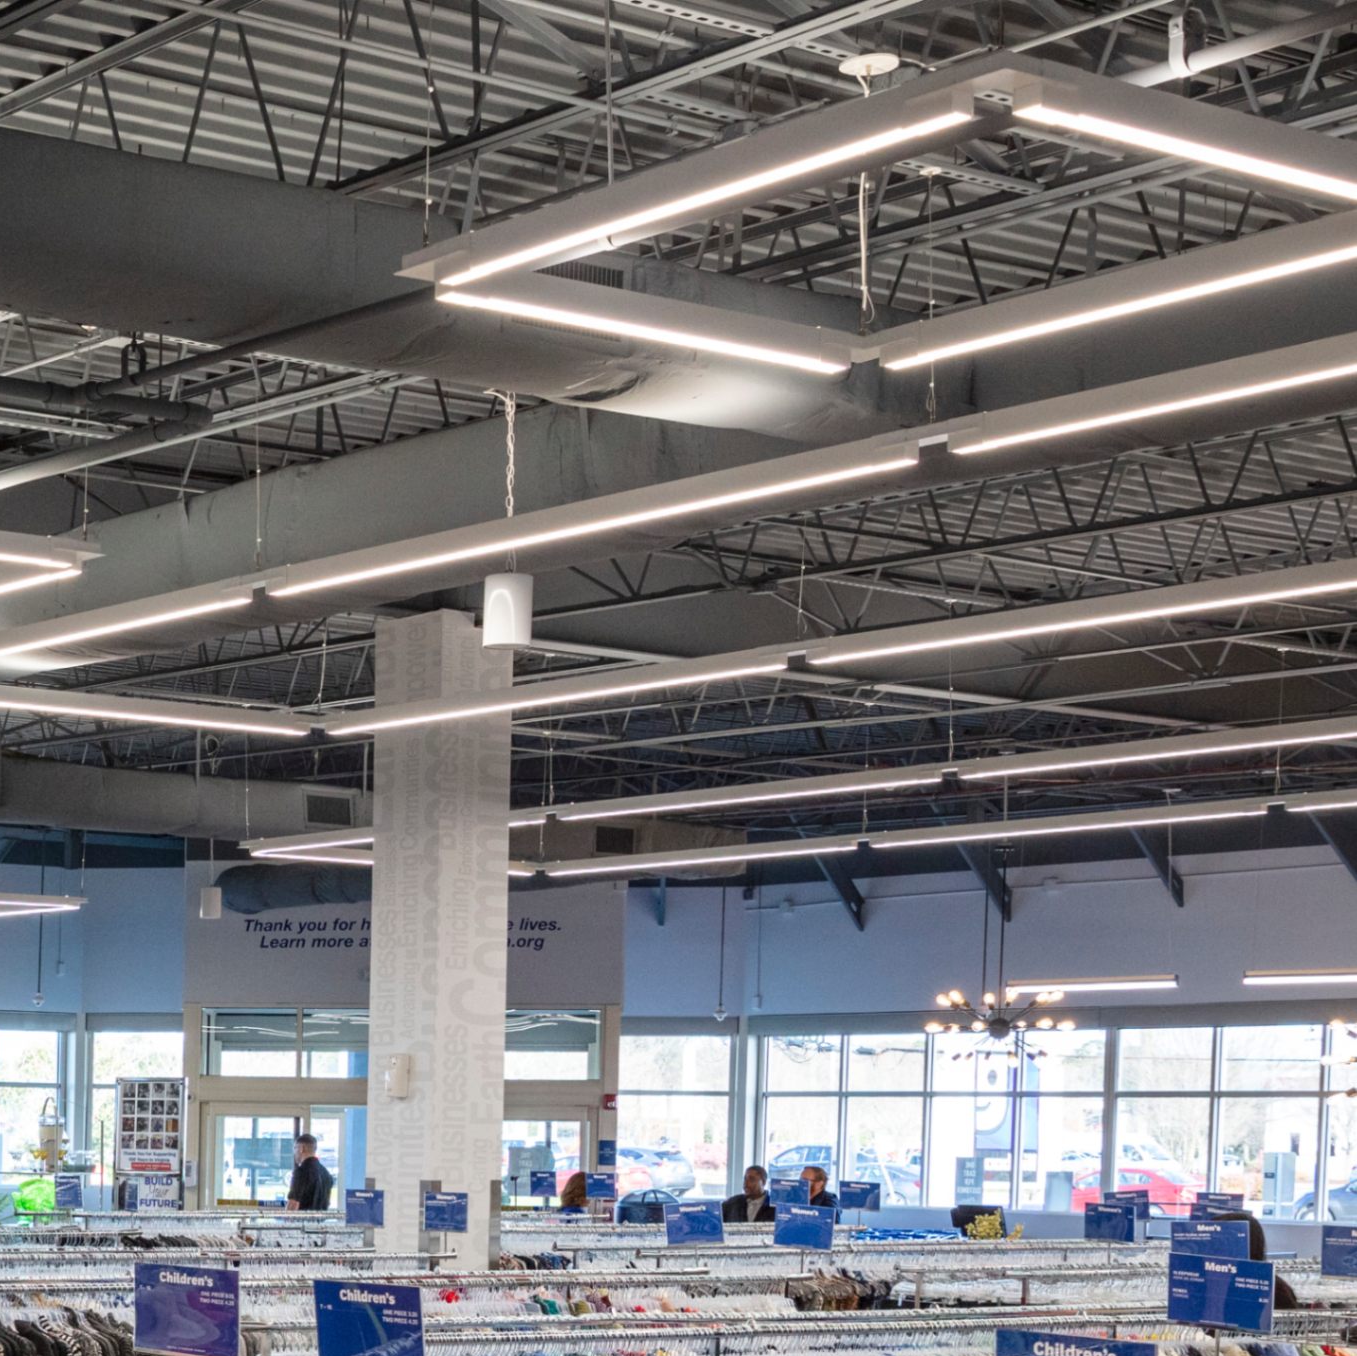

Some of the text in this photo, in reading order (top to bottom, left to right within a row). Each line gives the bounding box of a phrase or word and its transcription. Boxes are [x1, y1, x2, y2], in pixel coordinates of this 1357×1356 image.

[243, 919, 292, 932] Thank
[298, 921, 328, 934] you
[333, 919, 357, 932] for
[445, 878, 474, 971] Enriching
[519, 918, 562, 931] lives.
[260, 936, 372, 949] Learn more a
[370, 908, 398, 1048] Businesses
[435, 1024, 468, 1185] Businesses
[144, 1177, 173, 1186] BUILD
[139, 1199, 178, 1208] FUTURE
[1197, 1224, 1221, 1232] Men's
[1204, 1261, 1237, 1274] Men's
[159, 1271, 214, 1287] Children's
[339, 1289, 396, 1305] Children's
